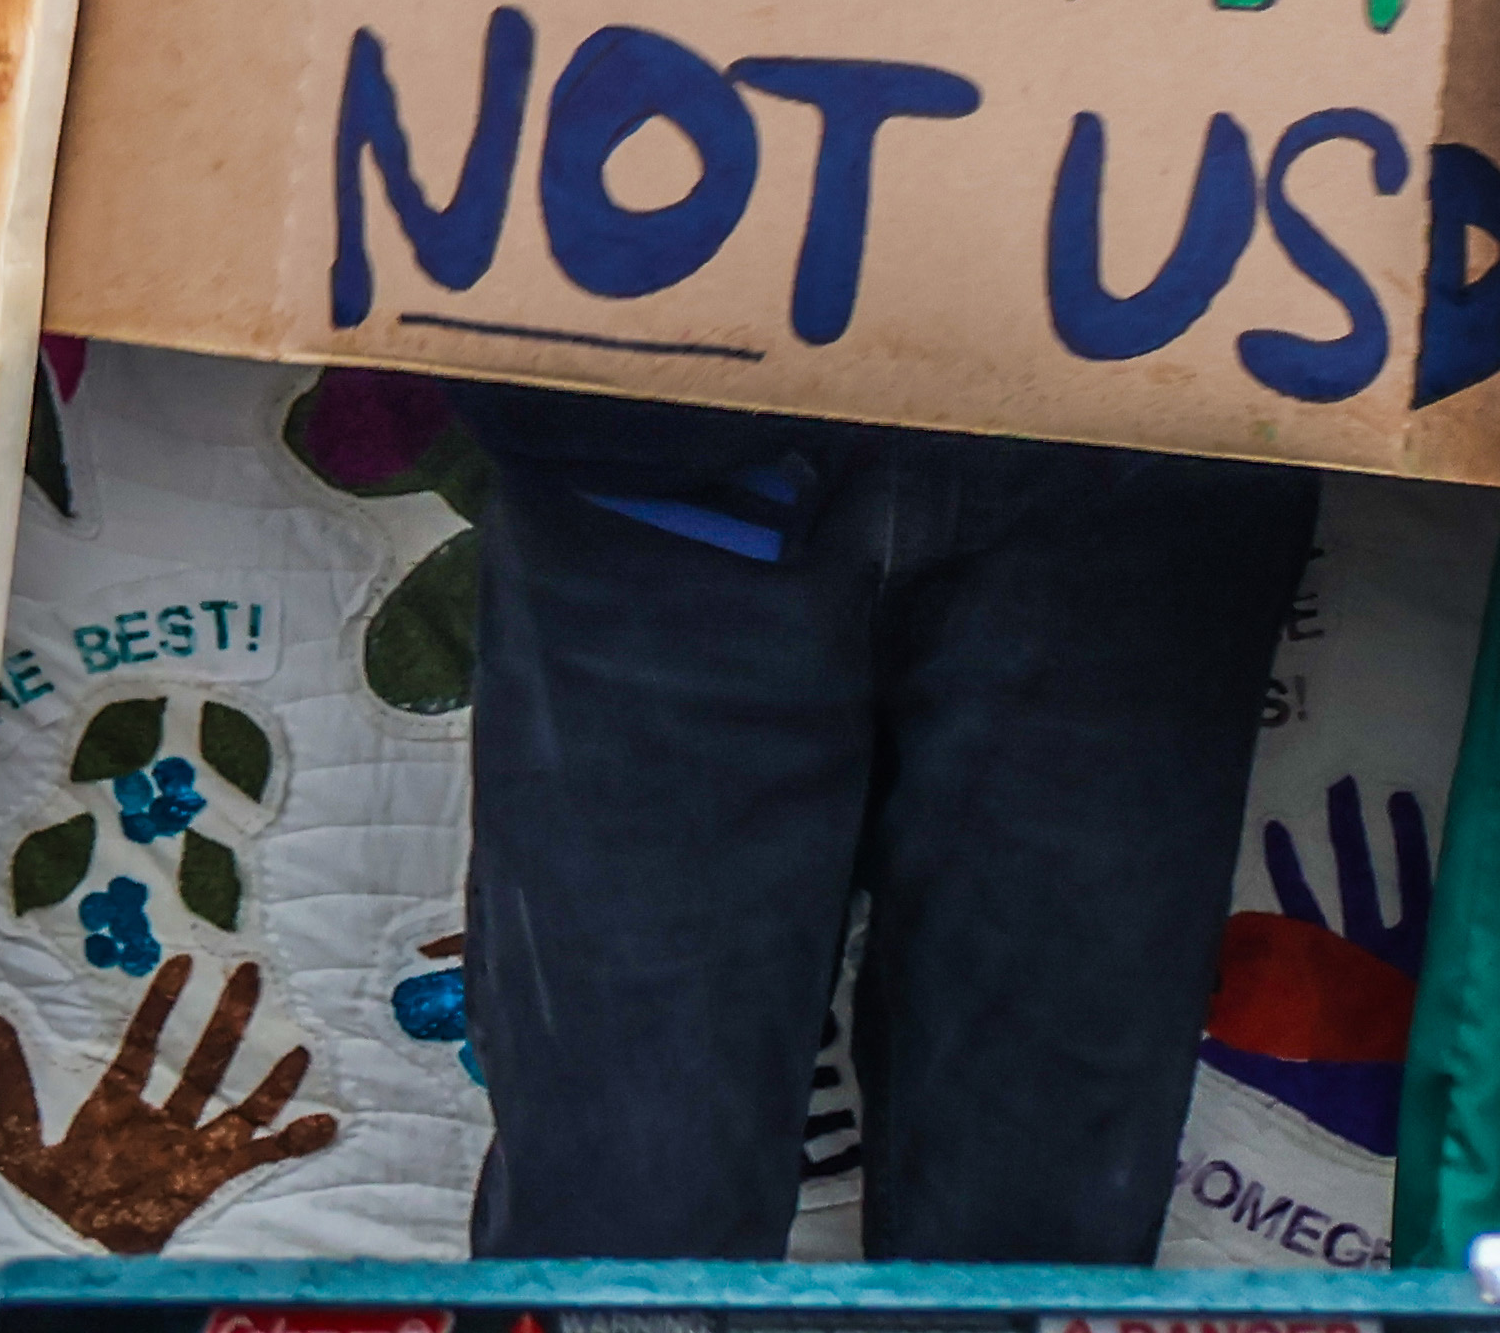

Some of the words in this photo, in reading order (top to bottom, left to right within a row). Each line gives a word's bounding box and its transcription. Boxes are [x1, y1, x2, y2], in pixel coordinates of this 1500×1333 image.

[330, 7, 982, 345] NOT
[72, 599, 265, 675] BEST!
[1176, 1151, 1393, 1269] OMEG
